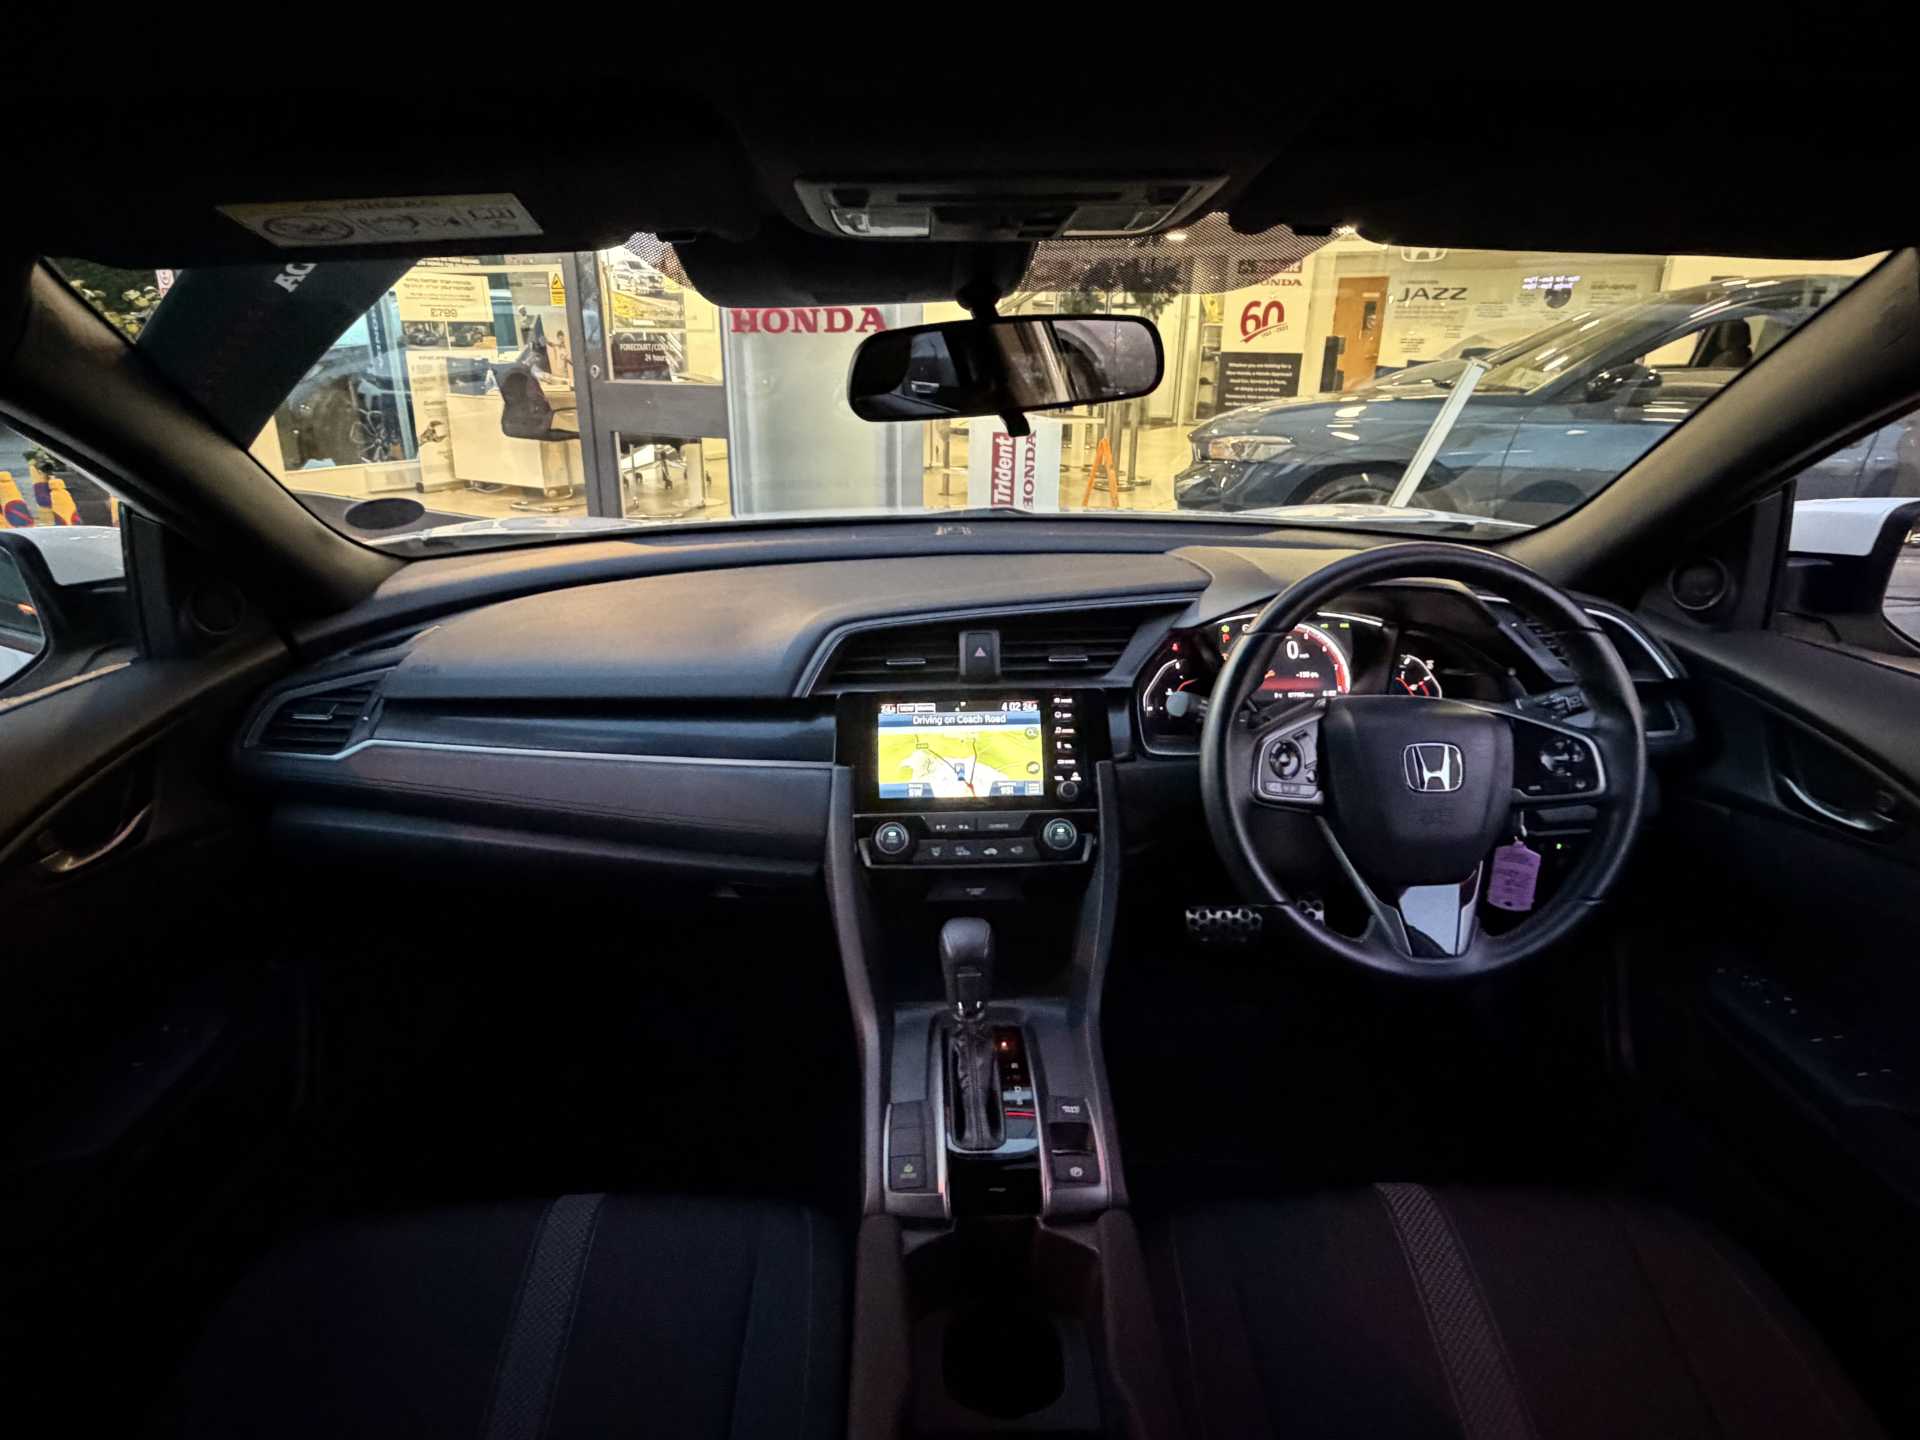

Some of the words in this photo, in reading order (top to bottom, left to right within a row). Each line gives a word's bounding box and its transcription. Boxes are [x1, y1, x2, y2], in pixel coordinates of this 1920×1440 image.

[1396, 287, 1468, 303] JAZZ
[730, 307, 888, 334] HONDA
[993, 436, 1014, 503] Trident
[1286, 640, 1299, 660] 0
[912, 715, 943, 726] Driving
[956, 714, 983, 724] Coach
